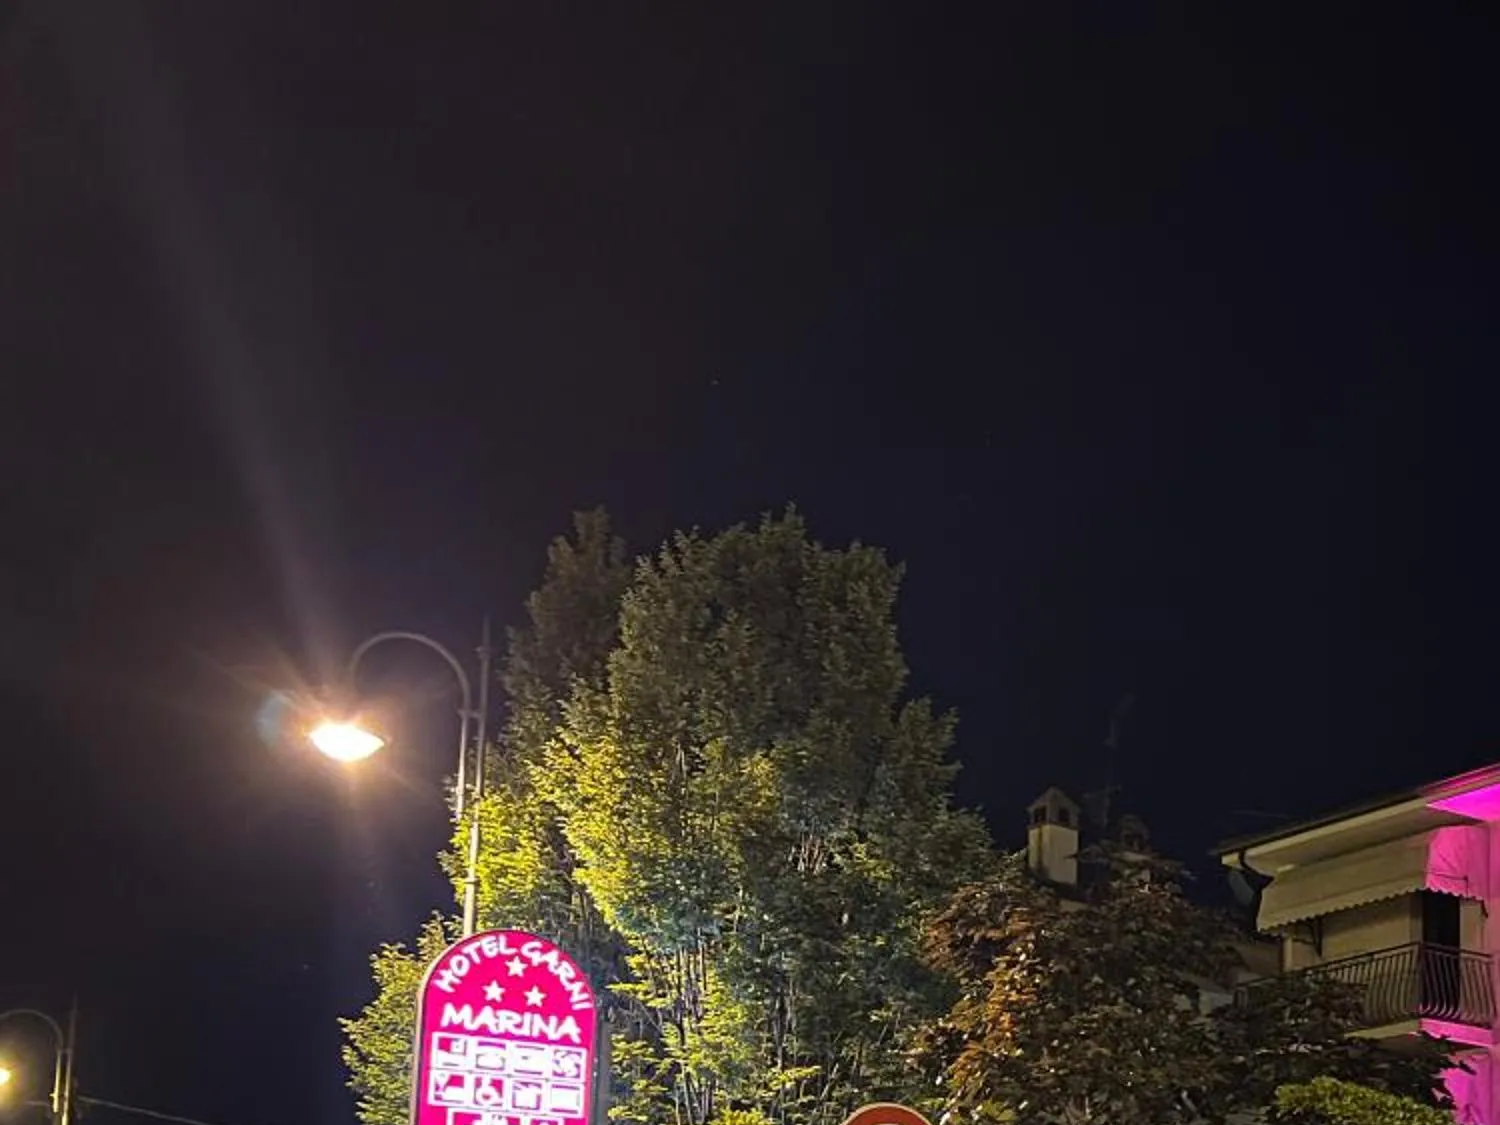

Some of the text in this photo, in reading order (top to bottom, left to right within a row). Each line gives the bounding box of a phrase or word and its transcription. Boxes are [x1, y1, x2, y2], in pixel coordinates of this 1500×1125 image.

[432, 934, 594, 1011] HOTEL GARNI
[440, 1002, 582, 1044] MARINA
